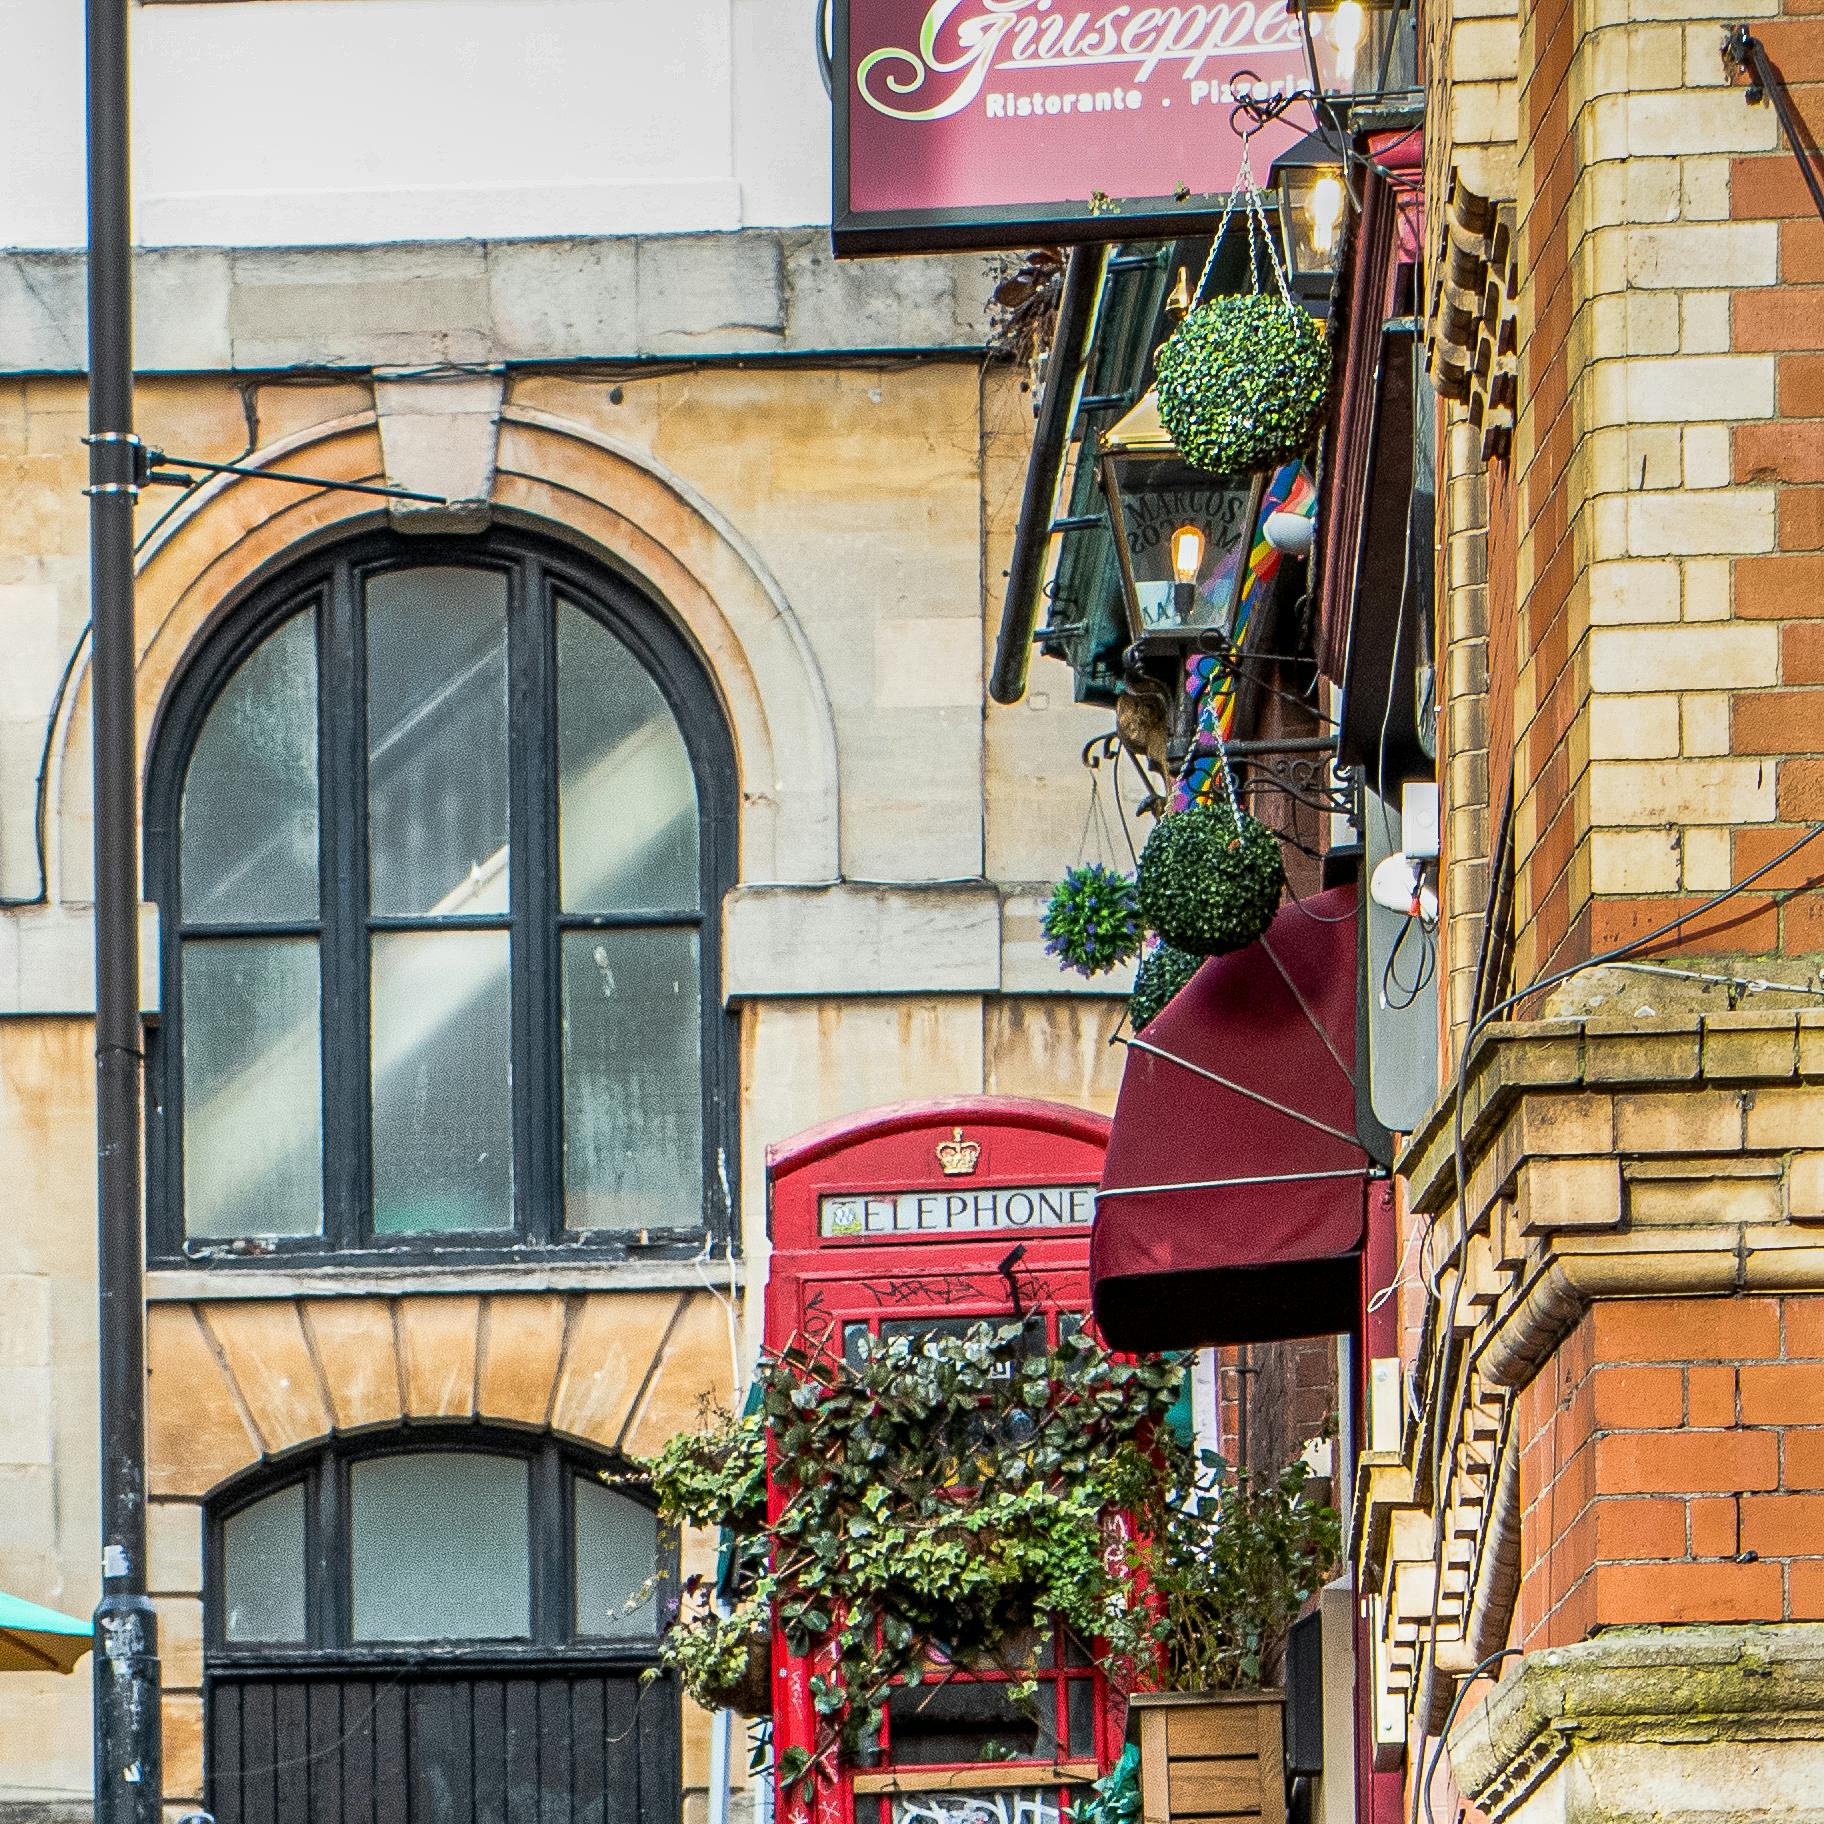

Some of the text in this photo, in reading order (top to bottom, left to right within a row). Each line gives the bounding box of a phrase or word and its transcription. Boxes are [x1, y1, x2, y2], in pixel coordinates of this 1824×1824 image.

[985, 74, 1313, 118] Ristorante Pizzeria
[1125, 490, 1243, 528] MARCOS
